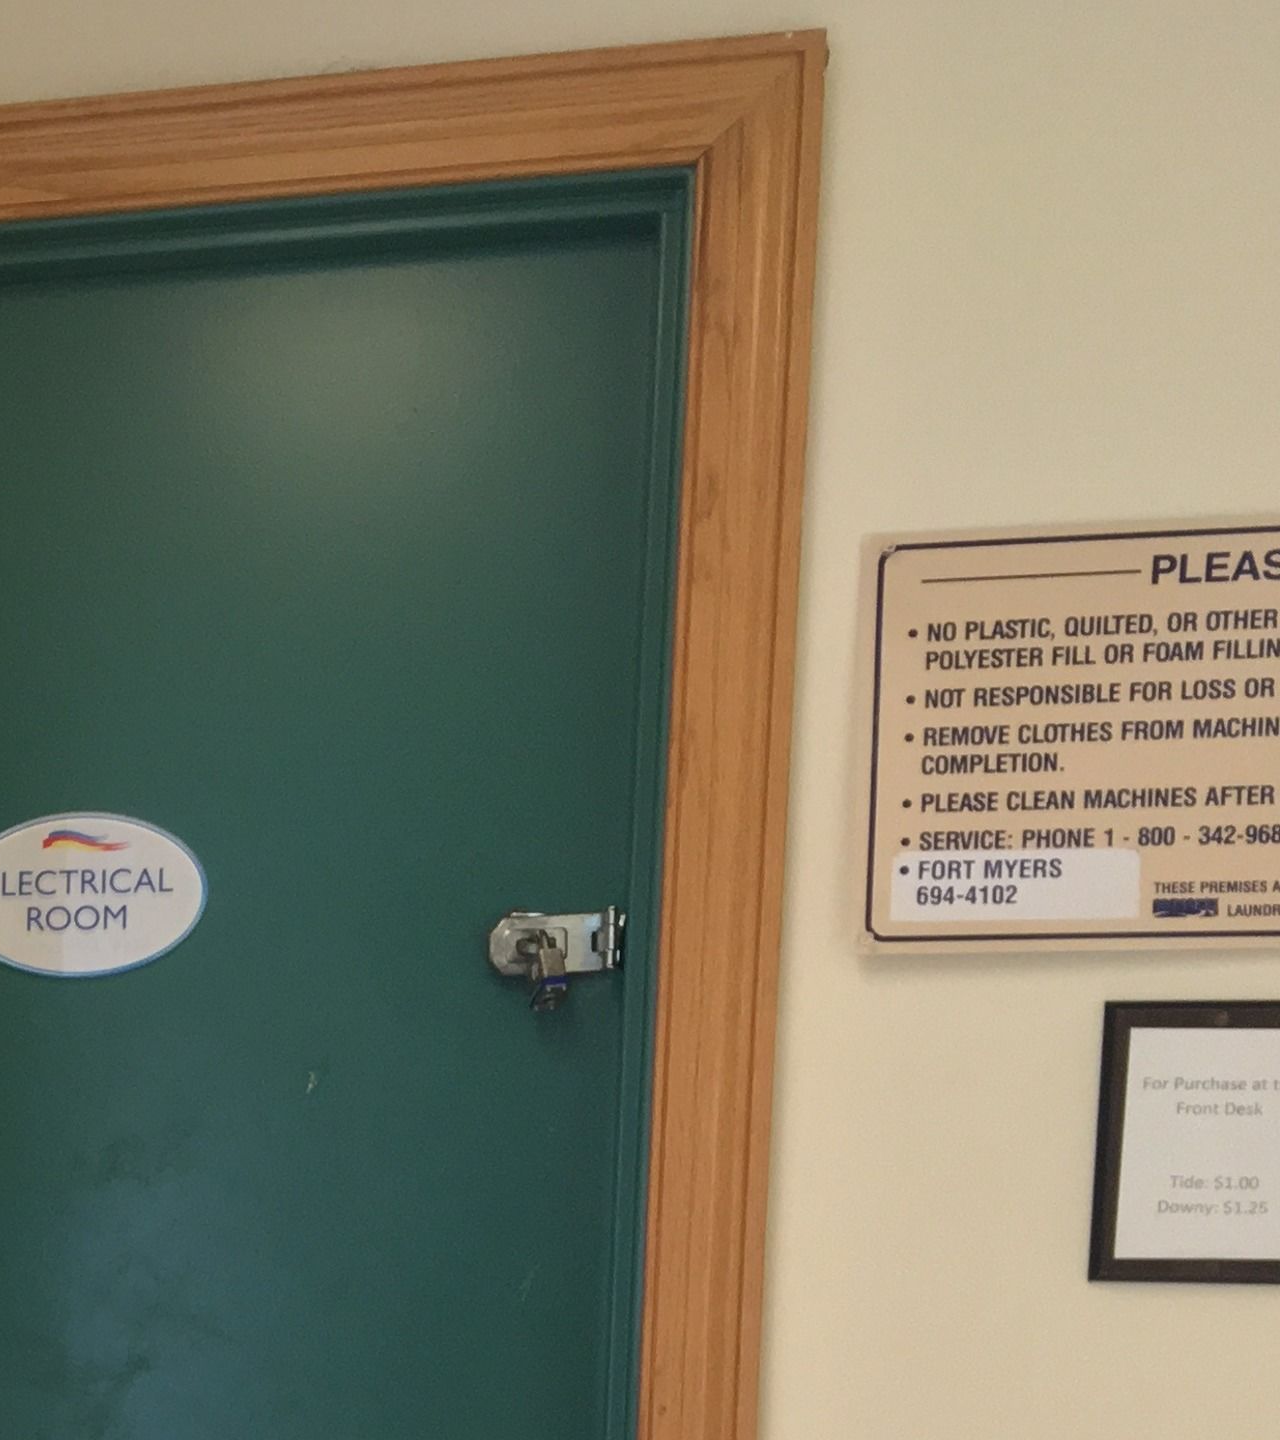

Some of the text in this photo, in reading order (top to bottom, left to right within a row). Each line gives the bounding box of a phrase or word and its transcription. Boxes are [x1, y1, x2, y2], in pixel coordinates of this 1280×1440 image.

[927, 608, 1278, 642] NO PLASTIC, QUILTED, OR OTHER
[925, 638, 1280, 670] POLYESTER FILL OR FOAM FILLIN
[924, 677, 1275, 709] NOT RESPONSIBLE FOR LOSS OR
[923, 717, 1280, 747] REMOVE CLOTHES FROM MACHIN
[921, 752, 1065, 775] COMPLETION.
[921, 785, 1275, 812] PLEASE CLEAN MACHINES AFTER
[919, 829, 1013, 851] SERVICE:
[1022, 827, 1095, 849] PHONE
[1103, 828, 1114, 847] 1
[1138, 826, 1176, 846] 800
[918, 858, 1062, 880] FORT MYERS
[916, 884, 1018, 905] 694-4102
[1154, 881, 1195, 893] THESE
[1200, 880, 1267, 893] PREMISES
[26, 905, 127, 932] ROOM
[1143, 1076, 1168, 1090] For
[1174, 1076, 1247, 1090] Purchase
[1252, 1078, 1267, 1090] at
[1177, 1101, 1263, 1115] Front Desk
[1170, 1175, 1259, 1190] Tide: $1.00
[1158, 1199, 1269, 1216] Downy: $1.25
